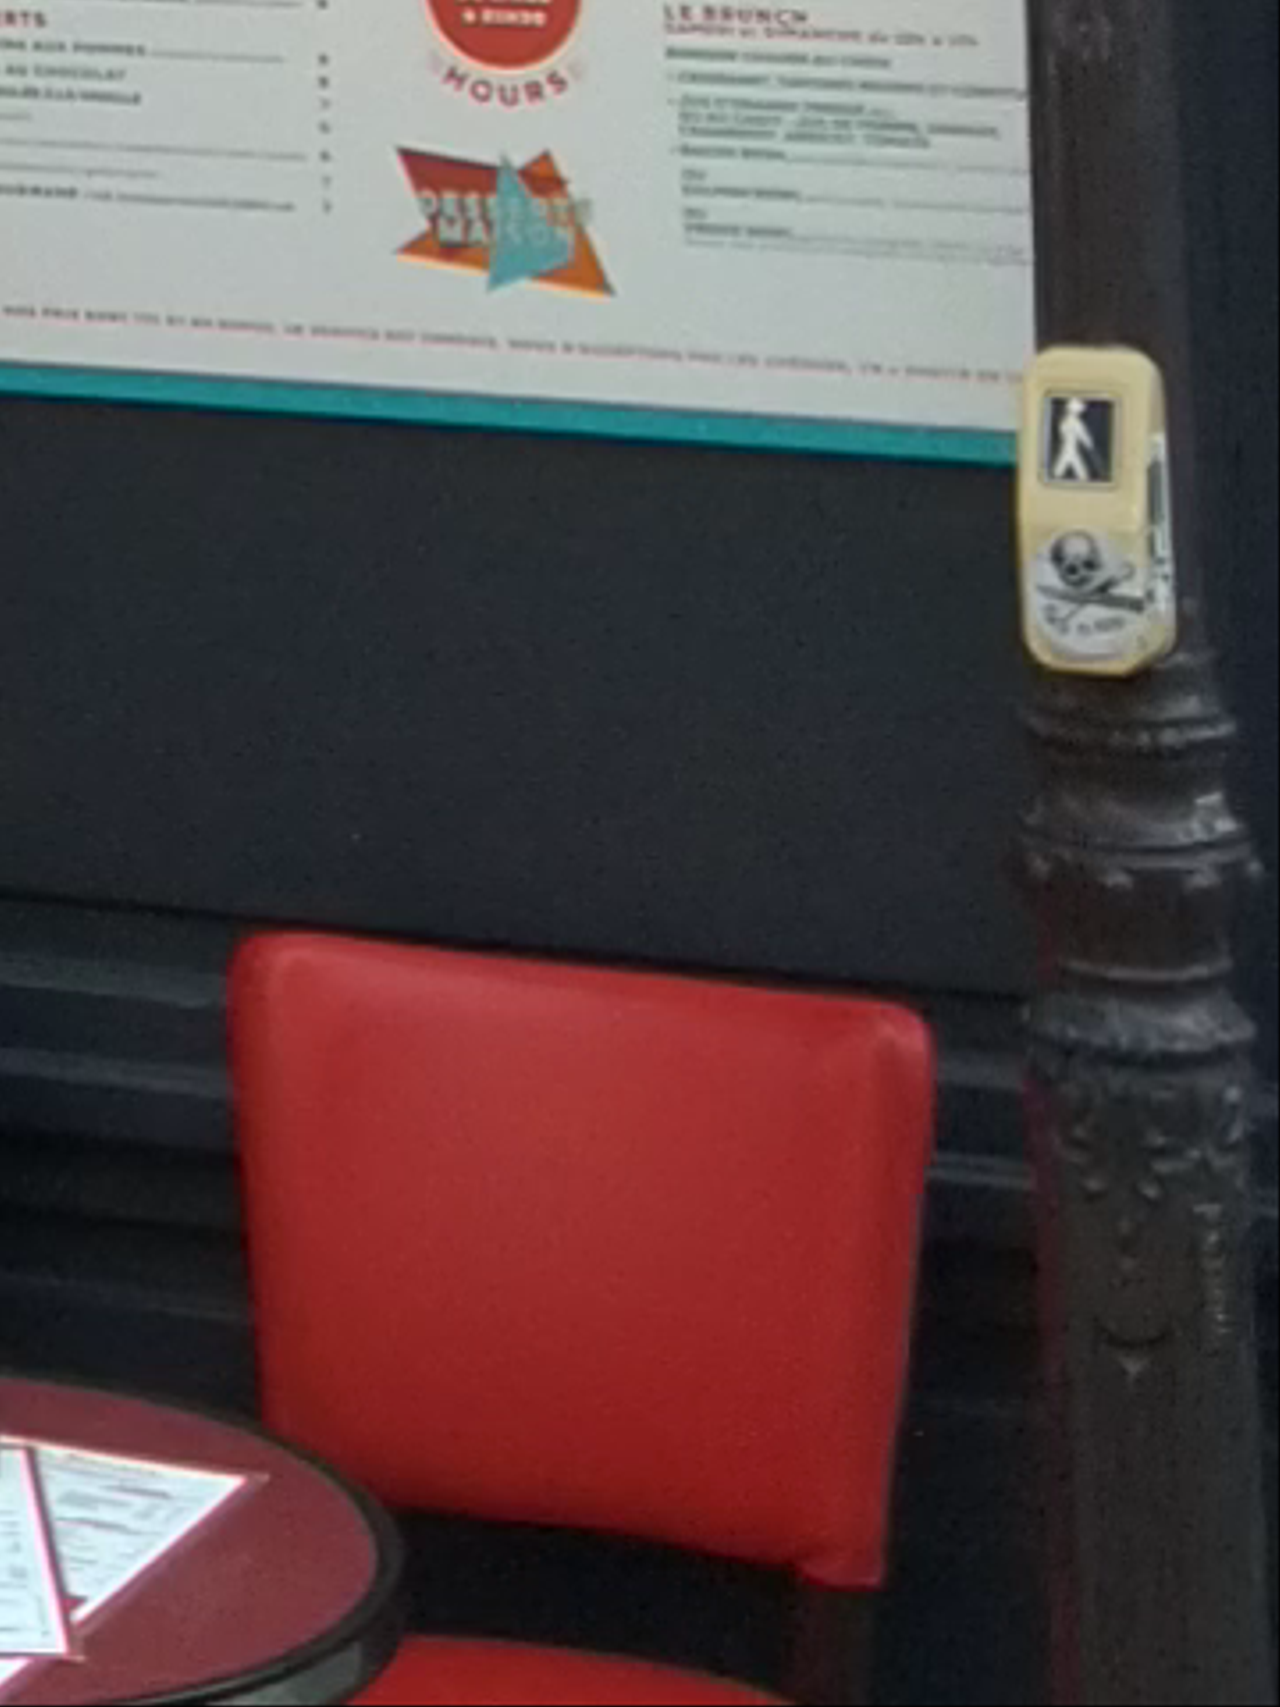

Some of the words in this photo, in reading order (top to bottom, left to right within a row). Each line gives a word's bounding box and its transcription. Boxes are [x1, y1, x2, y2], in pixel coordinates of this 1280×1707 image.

[663, 3, 693, 22] LE
[702, 5, 809, 27] BRUNCH
[441, 64, 571, 109] HOURS
